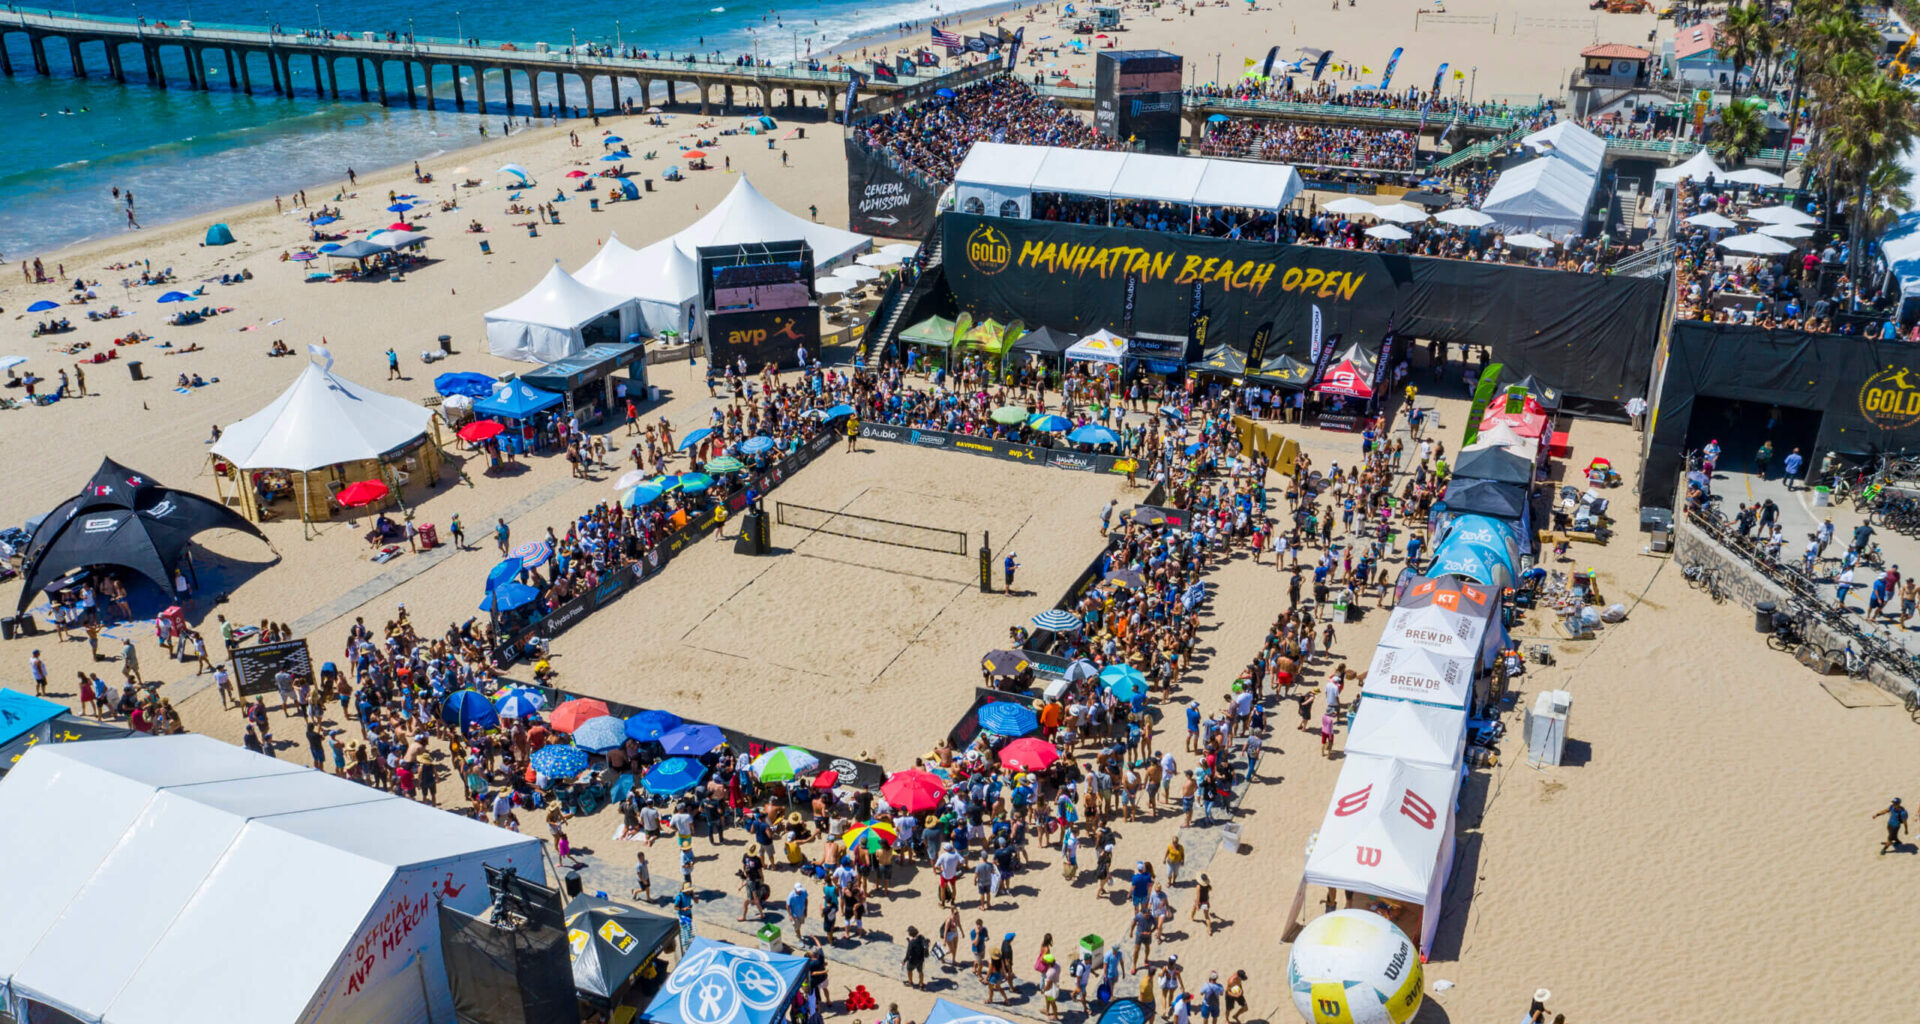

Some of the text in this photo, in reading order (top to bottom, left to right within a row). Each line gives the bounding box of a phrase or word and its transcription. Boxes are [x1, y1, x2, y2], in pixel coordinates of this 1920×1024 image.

[864, 182, 904, 198] GENERAL
[859, 193, 911, 212] ADMISSION
[971, 242, 1006, 264] GOLD
[1018, 240, 1367, 303] MANHATTAN BEACH OPEN
[728, 327, 767, 346] avp
[1312, 310, 1320, 358] ROCKWELL
[1137, 339, 1160, 350] Aubio
[1321, 385, 1360, 396] ROCKWELL
[1865, 387, 1920, 415] GOLD
[870, 428, 897, 439] Aubio
[1008, 449, 1023, 458] avp
[1437, 594, 1456, 603] KT
[554, 604, 584, 627] Hydro Flask
[1405, 628, 1438, 642] BREW
[503, 644, 516, 660] KT
[1390, 674, 1424, 687] BREW
[356, 895, 410, 962] OFFICIAL
[347, 892, 428, 994] AVP MERCH
[1383, 941, 1409, 981] Wilson
